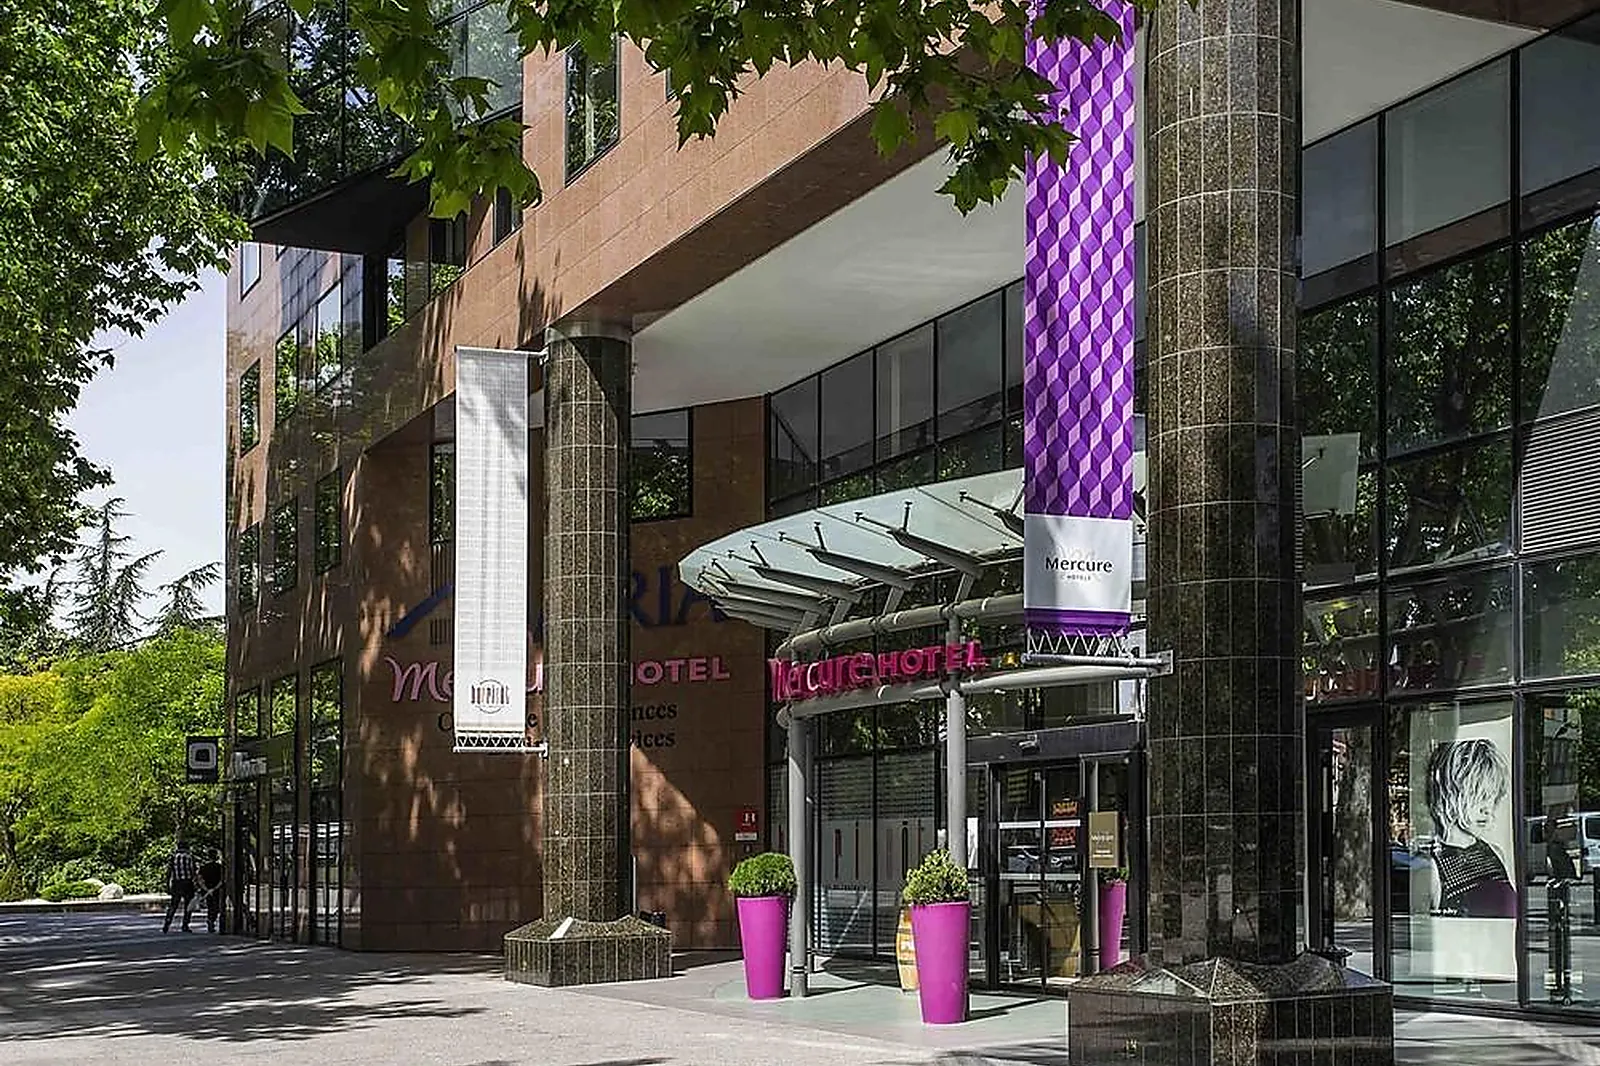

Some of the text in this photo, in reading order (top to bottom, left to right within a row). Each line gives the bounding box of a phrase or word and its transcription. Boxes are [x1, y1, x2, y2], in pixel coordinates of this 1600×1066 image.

[1045, 556, 1113, 574] Mercure
[630, 657, 731, 686] OTEL
[878, 641, 987, 679] HOTEL
